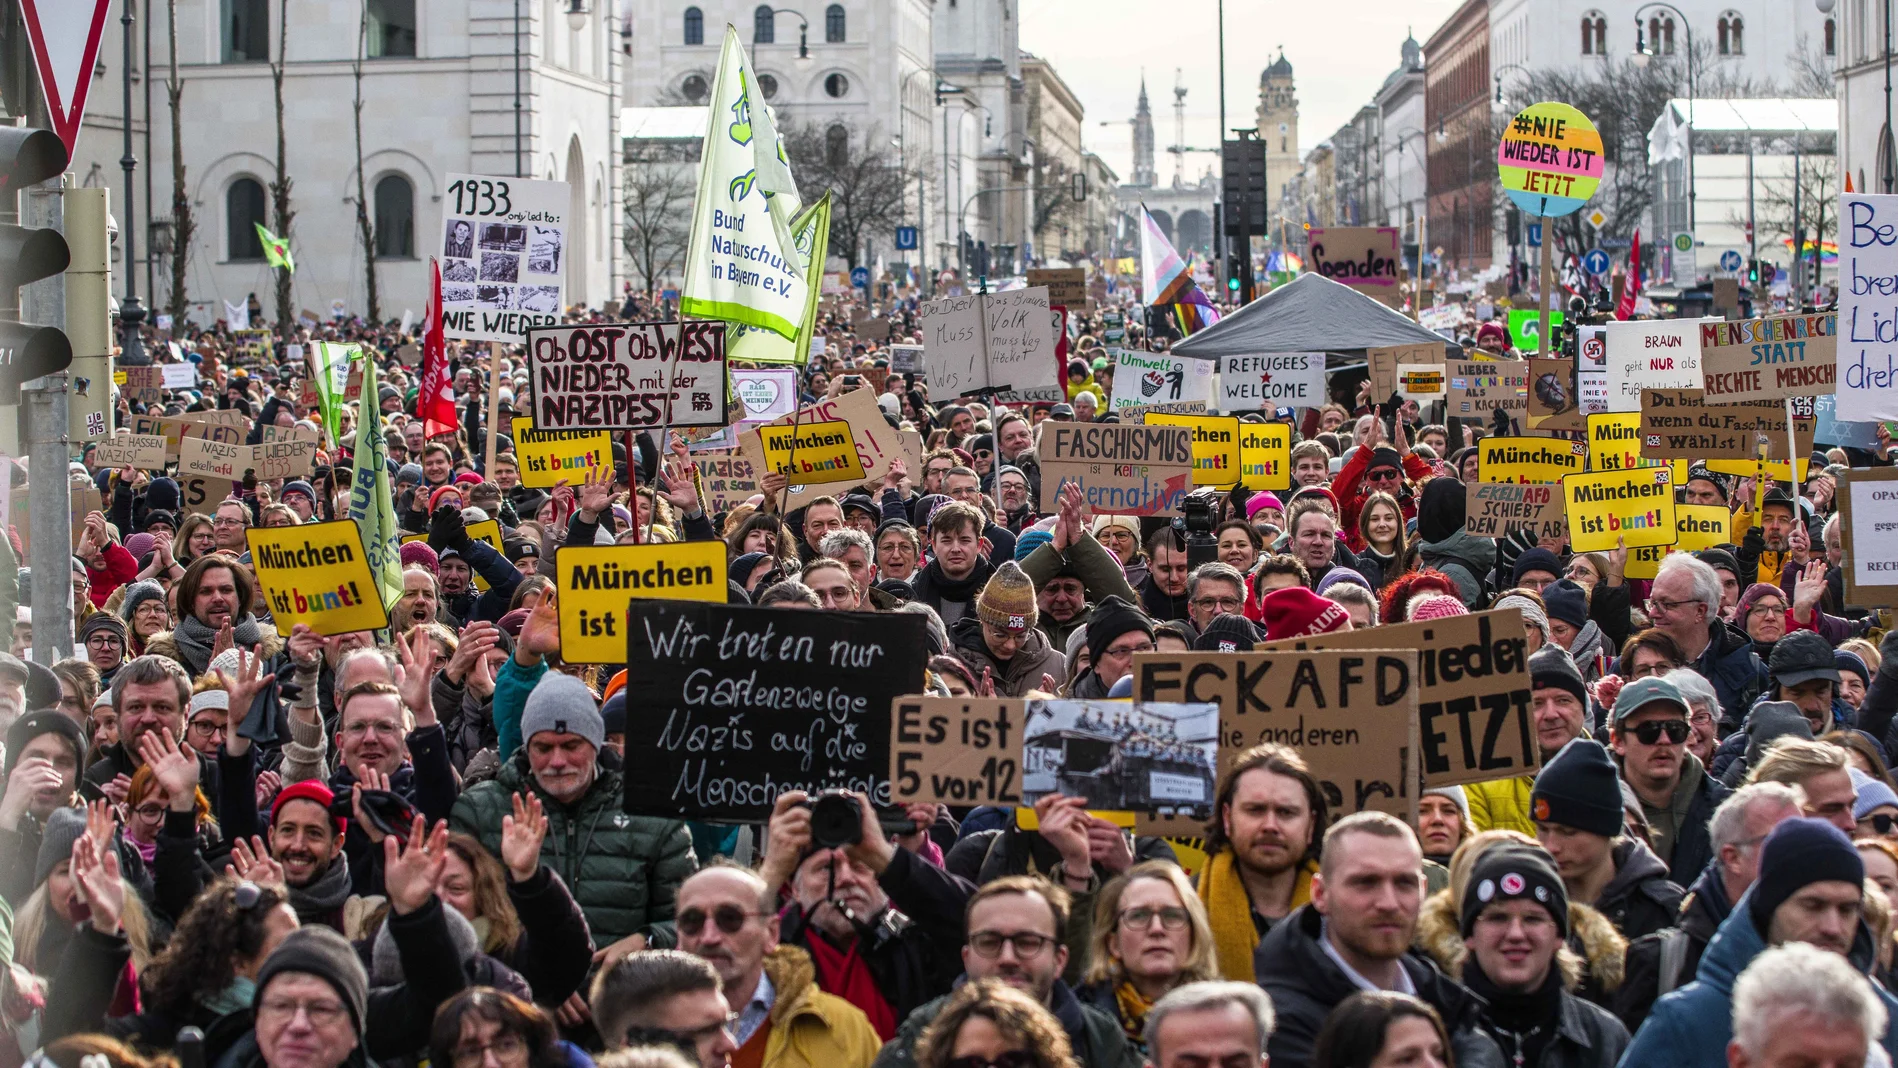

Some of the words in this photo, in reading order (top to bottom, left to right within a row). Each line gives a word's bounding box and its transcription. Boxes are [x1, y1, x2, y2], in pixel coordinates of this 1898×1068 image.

[1514, 113, 1566, 140] #NIE
[1504, 138, 1560, 166] WIEDER
[1567, 147, 1596, 171] IST
[1522, 170, 1576, 197] JETZT
[448, 180, 512, 217] 1933
[528, 211, 542, 222] led
[714, 209, 746, 233] Bund
[900, 230, 912, 246] U
[711, 260, 723, 280] in
[728, 262, 760, 288] Bayern
[763, 276, 793, 299] e.V.
[442, 311, 476, 332] NIE
[1702, 316, 1838, 348] MENSCHENRECH
[568, 328, 626, 363] OST
[655, 322, 725, 363] WEST
[1645, 335, 1682, 349] BRAUN
[1120, 353, 1171, 371] Umwelt
[1750, 341, 1806, 366] STATT
[1229, 355, 1309, 374] REFUGEES
[1458, 364, 1498, 376] LIEBER
[1625, 360, 1643, 377] geht
[1650, 358, 1674, 371] NUR
[1681, 356, 1697, 369] als
[540, 362, 636, 393] NIEDER
[639, 369, 666, 390] mit
[672, 369, 698, 389] der
[1147, 370, 1165, 386] AfD
[1475, 377, 1528, 387] KUNTERBU
[1705, 370, 1762, 396] RECHTE
[1775, 363, 1837, 388] MENSCH
[692, 392, 711, 401] FCK
[1024, 389, 1060, 402] KACKE
[1226, 383, 1308, 399] WELCOME
[1465, 387, 1486, 397] ALS
[1651, 391, 1675, 408] Du
[1679, 391, 1704, 408] bist
[542, 393, 680, 427] NAZIPEST
[1475, 399, 1527, 411] KACKBRAU
[1648, 416, 1693, 428] wenn
[1699, 412, 1721, 429] du
[1722, 414, 1809, 433] Faschistn
[128, 437, 163, 449] HASSEN
[201, 442, 238, 458] NAZIS
[266, 443, 308, 459] WIEDER
[769, 432, 846, 452] München
[1055, 427, 1190, 463] FASCHISMUS
[1241, 433, 1282, 449] chen
[1667, 434, 1735, 450] Wählst
[190, 459, 233, 476] ekelhafd
[260, 457, 291, 478] 1933
[527, 455, 547, 472] ist
[550, 449, 601, 471] bunt!
[776, 461, 799, 476] ist
[801, 454, 850, 474] bunt!
[1193, 454, 1228, 470] unt!
[1486, 446, 1576, 468] München
[1600, 453, 1620, 470] ist
[1089, 463, 1101, 474] ist
[1243, 460, 1279, 476] unt!
[1476, 486, 1550, 504] EKELHAFD
[1573, 480, 1664, 503] München
[1482, 501, 1545, 519] SCHIEBT
[1467, 516, 1497, 534] DEN
[1541, 522, 1562, 538] AB
[1580, 515, 1604, 534] ist
[1608, 508, 1662, 532] bunt!
[1678, 515, 1722, 533] chen
[1874, 521, 1898, 531] gege
[258, 541, 354, 569] München
[571, 560, 713, 590] München
[1867, 561, 1898, 571] RECH
[269, 587, 292, 614] ist
[292, 581, 363, 614] bunt!
[579, 609, 616, 637] ist
[1008, 621, 1025, 630] AFD
[1009, 615, 1025, 623] FCK
[644, 614, 711, 659] Wir
[717, 618, 815, 662] treten
[829, 640, 885, 668] nur
[1219, 641, 1236, 650] FCK
[1420, 616, 1526, 690] ieder
[1141, 660, 1274, 715] FCK
[1285, 655, 1411, 709] AFD
[683, 668, 868, 725] Gartenzwerge
[897, 704, 949, 746] Es
[960, 704, 1012, 749] ist
[1259, 714, 1360, 747] anderen
[1419, 689, 1532, 775] ETZT
[657, 708, 753, 752] Nazis
[770, 717, 826, 772] auf
[825, 722, 868, 762] die
[897, 752, 923, 796] 5
[931, 772, 985, 801] vor
[981, 757, 1020, 802] 12
